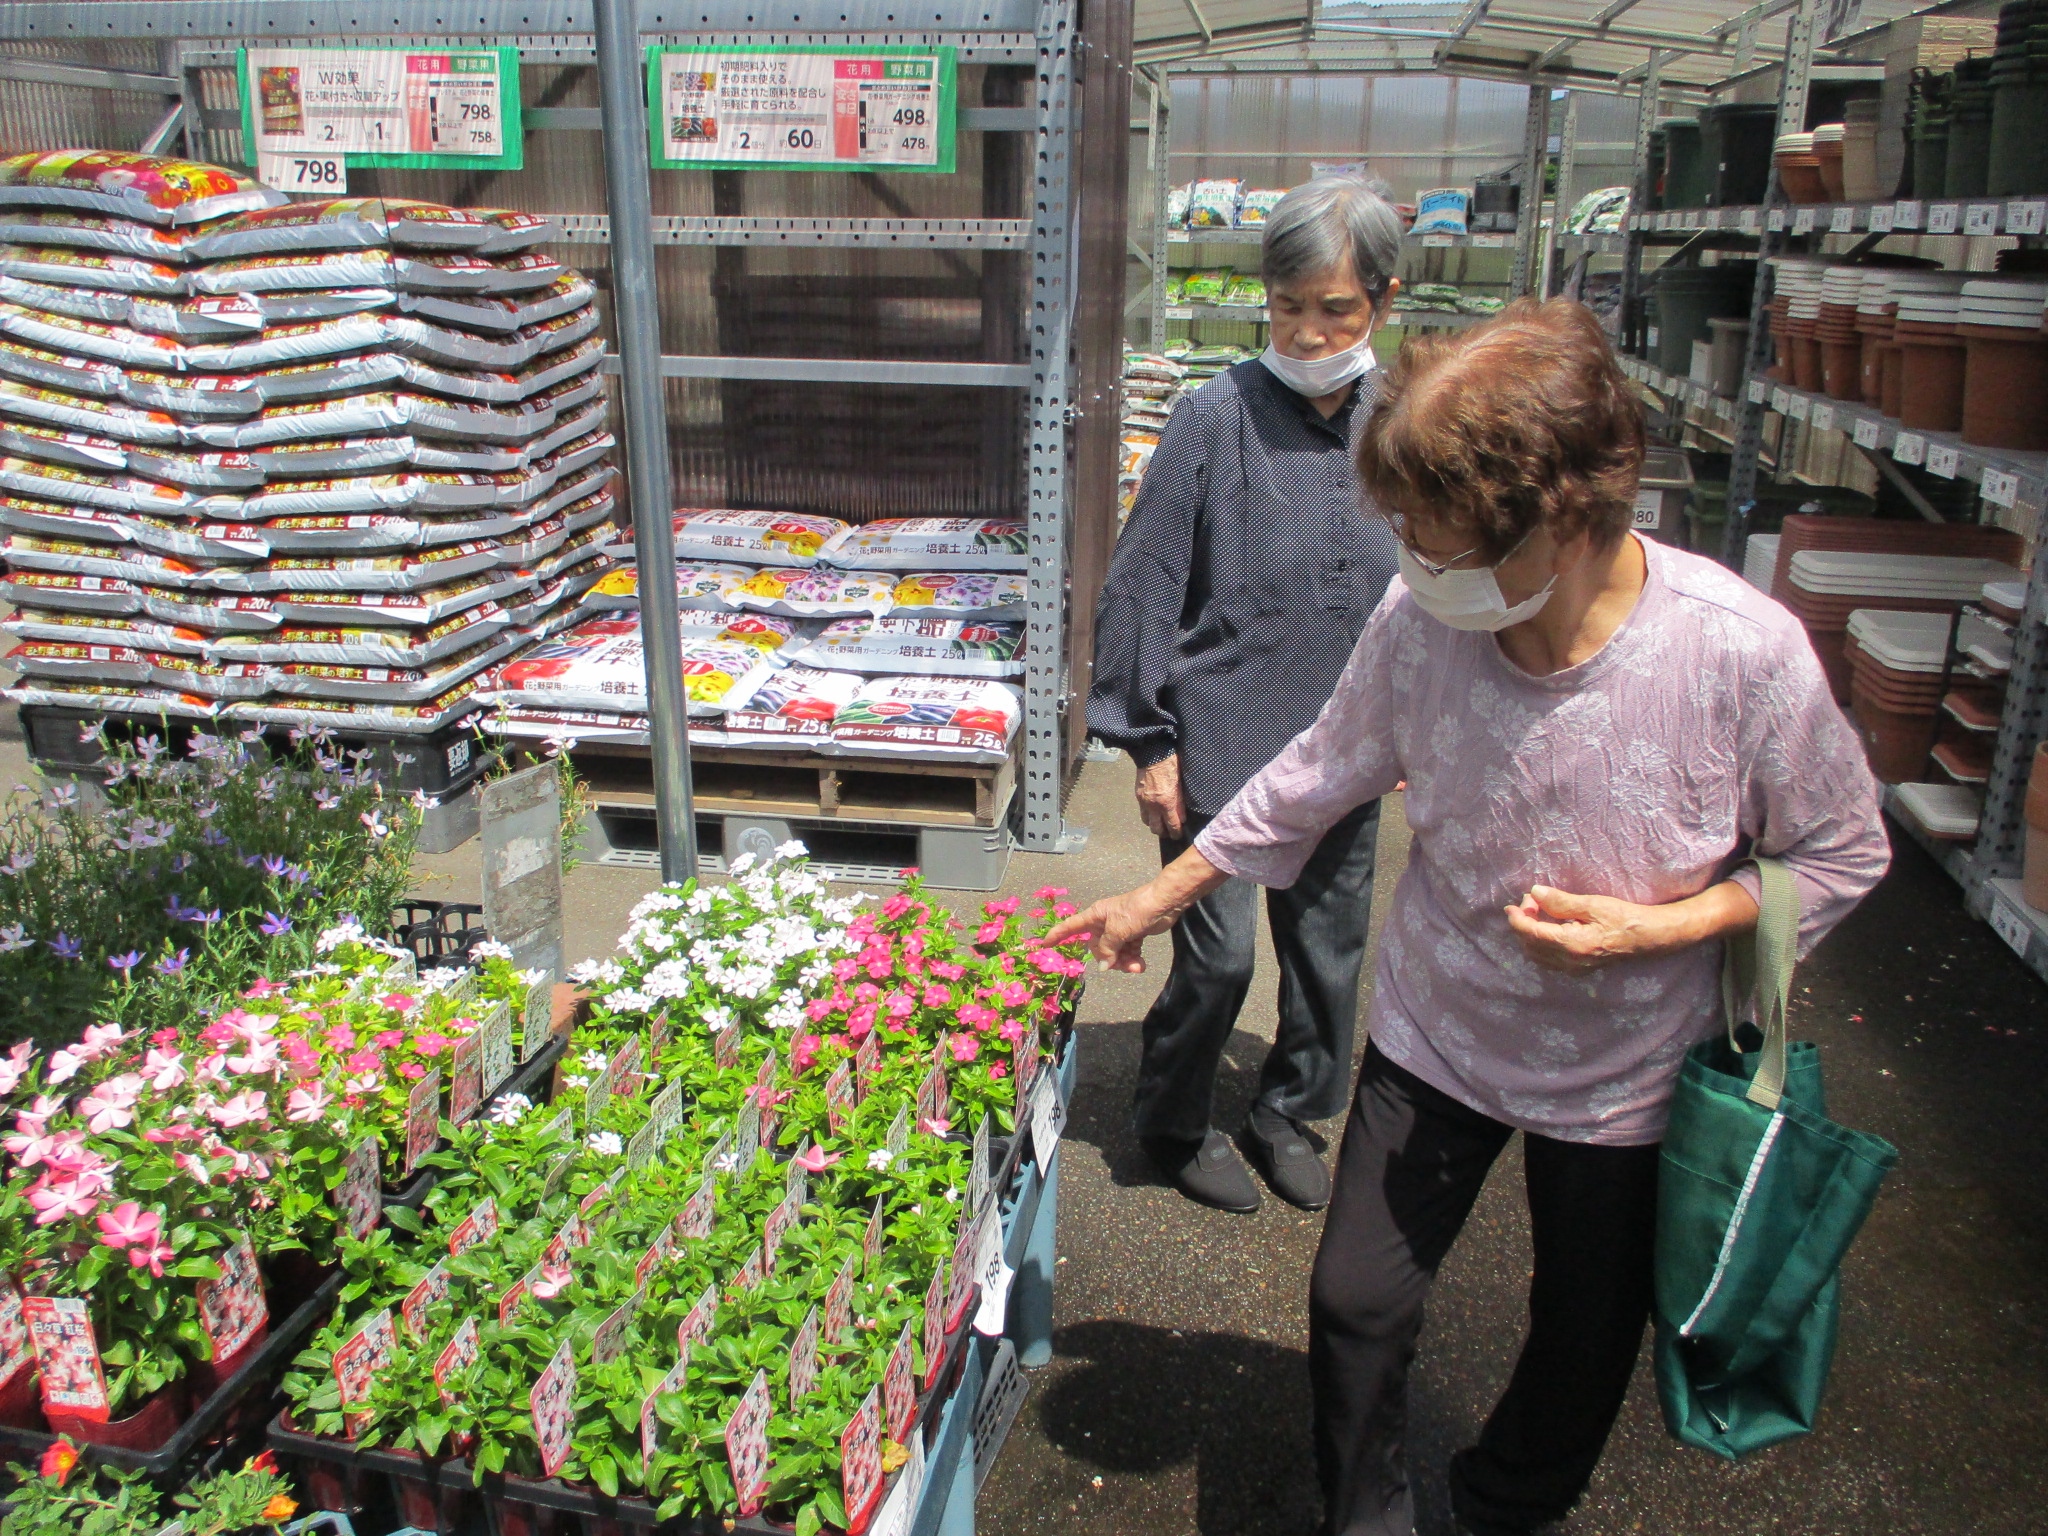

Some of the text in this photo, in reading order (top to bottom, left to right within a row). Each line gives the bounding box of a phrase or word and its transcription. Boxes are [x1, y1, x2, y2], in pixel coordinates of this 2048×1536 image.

[418, 59, 440, 71] 花用
[457, 59, 490, 71] 野菜用
[720, 61, 788, 72] 初期肥料入りで
[847, 64, 871, 76] 花用
[891, 64, 926, 76] 野菜用
[318, 71, 360, 85] W効果
[721, 74, 793, 85] そのまま使える。
[720, 87, 827, 98] 厳選された原料を配合し
[721, 99, 803, 110] 手軽に育てられる。
[1634, 510, 1655, 523] 80
[985, 1251, 1001, 1291] 198
[33, 1321, 63, 1335] 日々草
